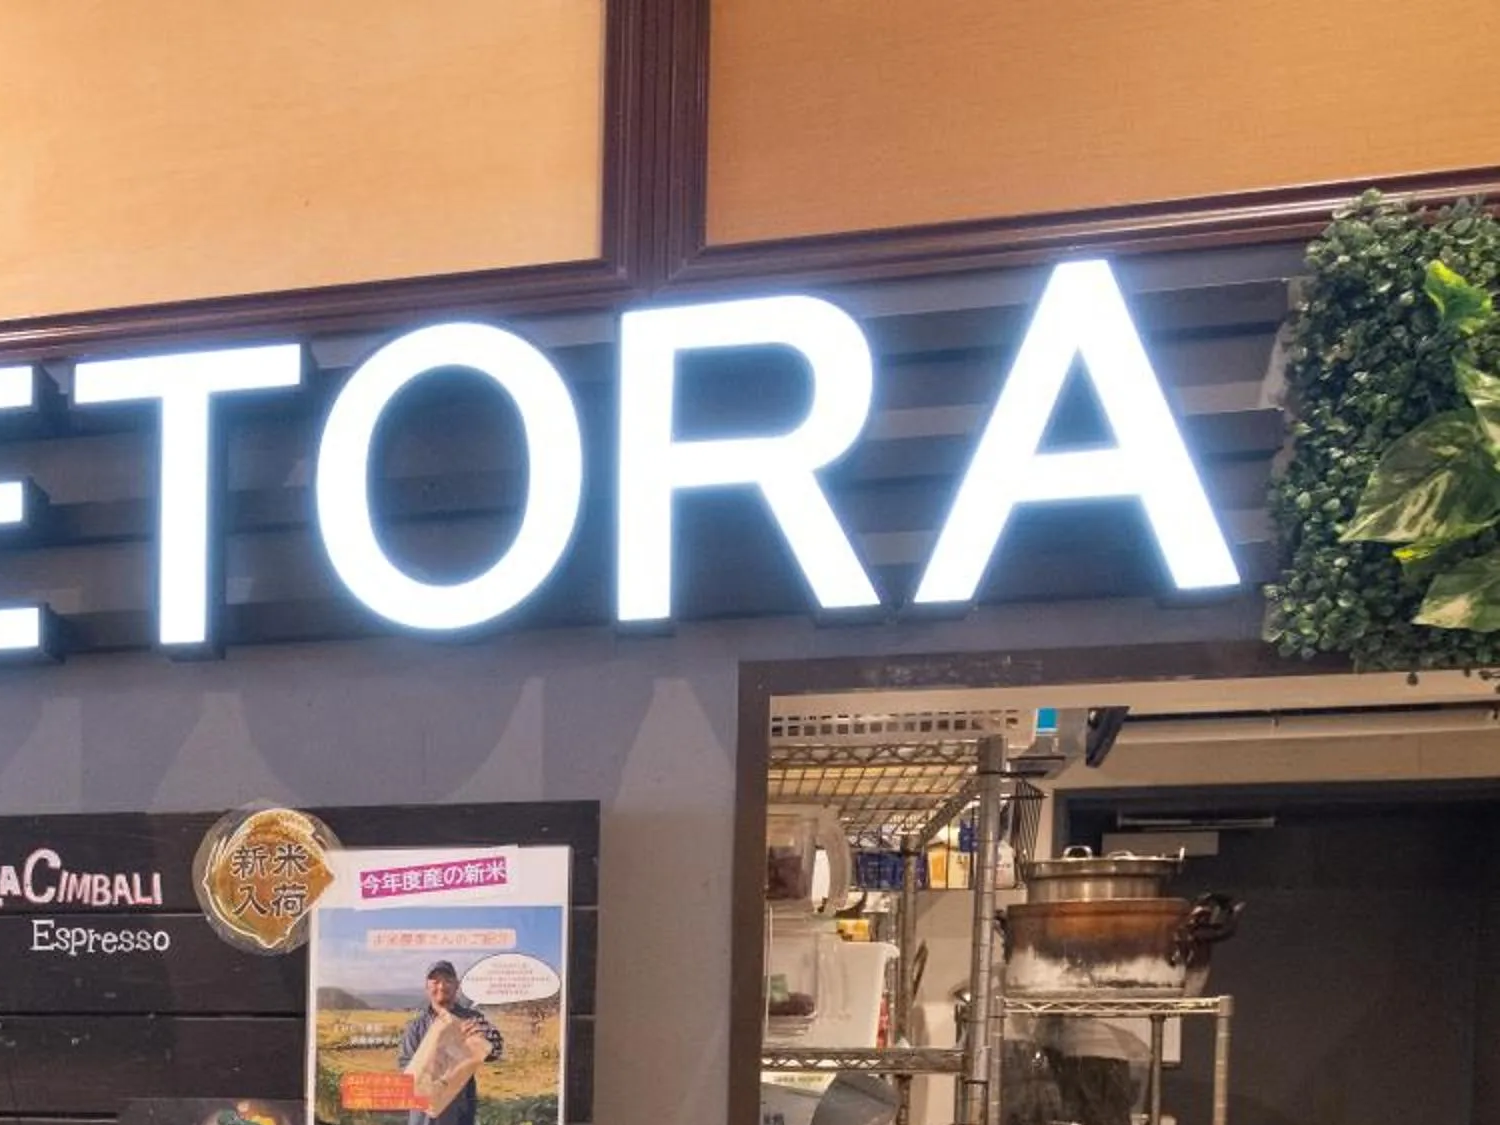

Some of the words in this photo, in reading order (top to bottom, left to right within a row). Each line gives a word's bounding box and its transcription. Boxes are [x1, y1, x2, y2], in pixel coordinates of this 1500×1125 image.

[232, 844, 308, 879] 新米
[362, 859, 505, 895] 今年度産の新米
[232, 882, 308, 918] 入荷
[30, 918, 171, 956] Espresso
